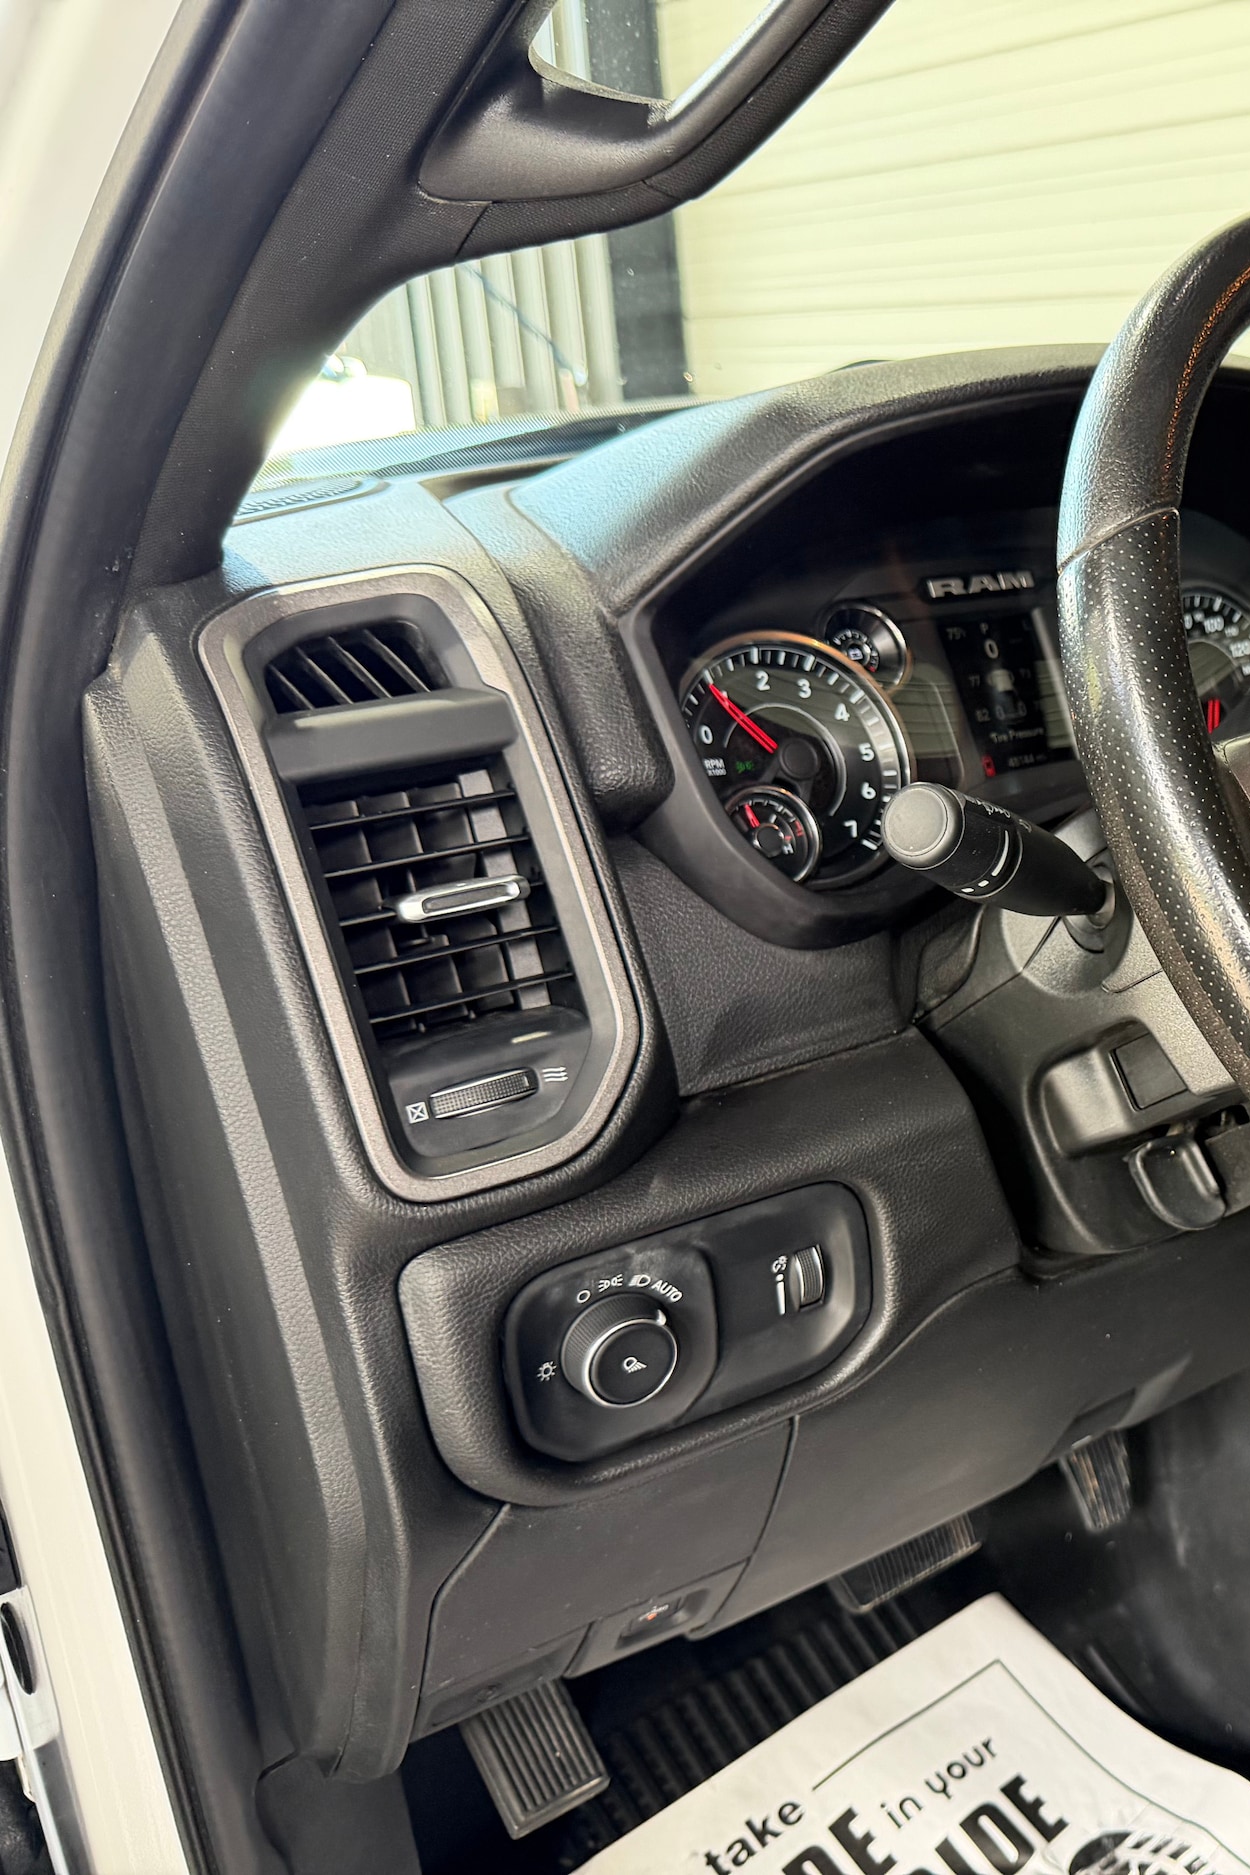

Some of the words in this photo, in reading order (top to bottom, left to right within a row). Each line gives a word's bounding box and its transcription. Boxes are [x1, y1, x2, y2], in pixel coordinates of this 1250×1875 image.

[926, 571, 1035, 598] RAM
[1204, 615, 1224, 633] 100
[984, 639, 999, 659] 0
[755, 670, 770, 691] 2
[798, 679, 812, 698] 3
[835, 703, 850, 722] 4
[700, 726, 713, 744] 0
[859, 743, 874, 761] 5
[704, 759, 725, 769] RPM
[861, 782, 876, 800] 6
[844, 820, 857, 838] 7
[651, 1280, 683, 1302] AUTO
[880, 1796, 923, 1829] in
[925, 1737, 998, 1799] your
[909, 1773, 1070, 1875] IDE
[704, 1800, 806, 1875] take
